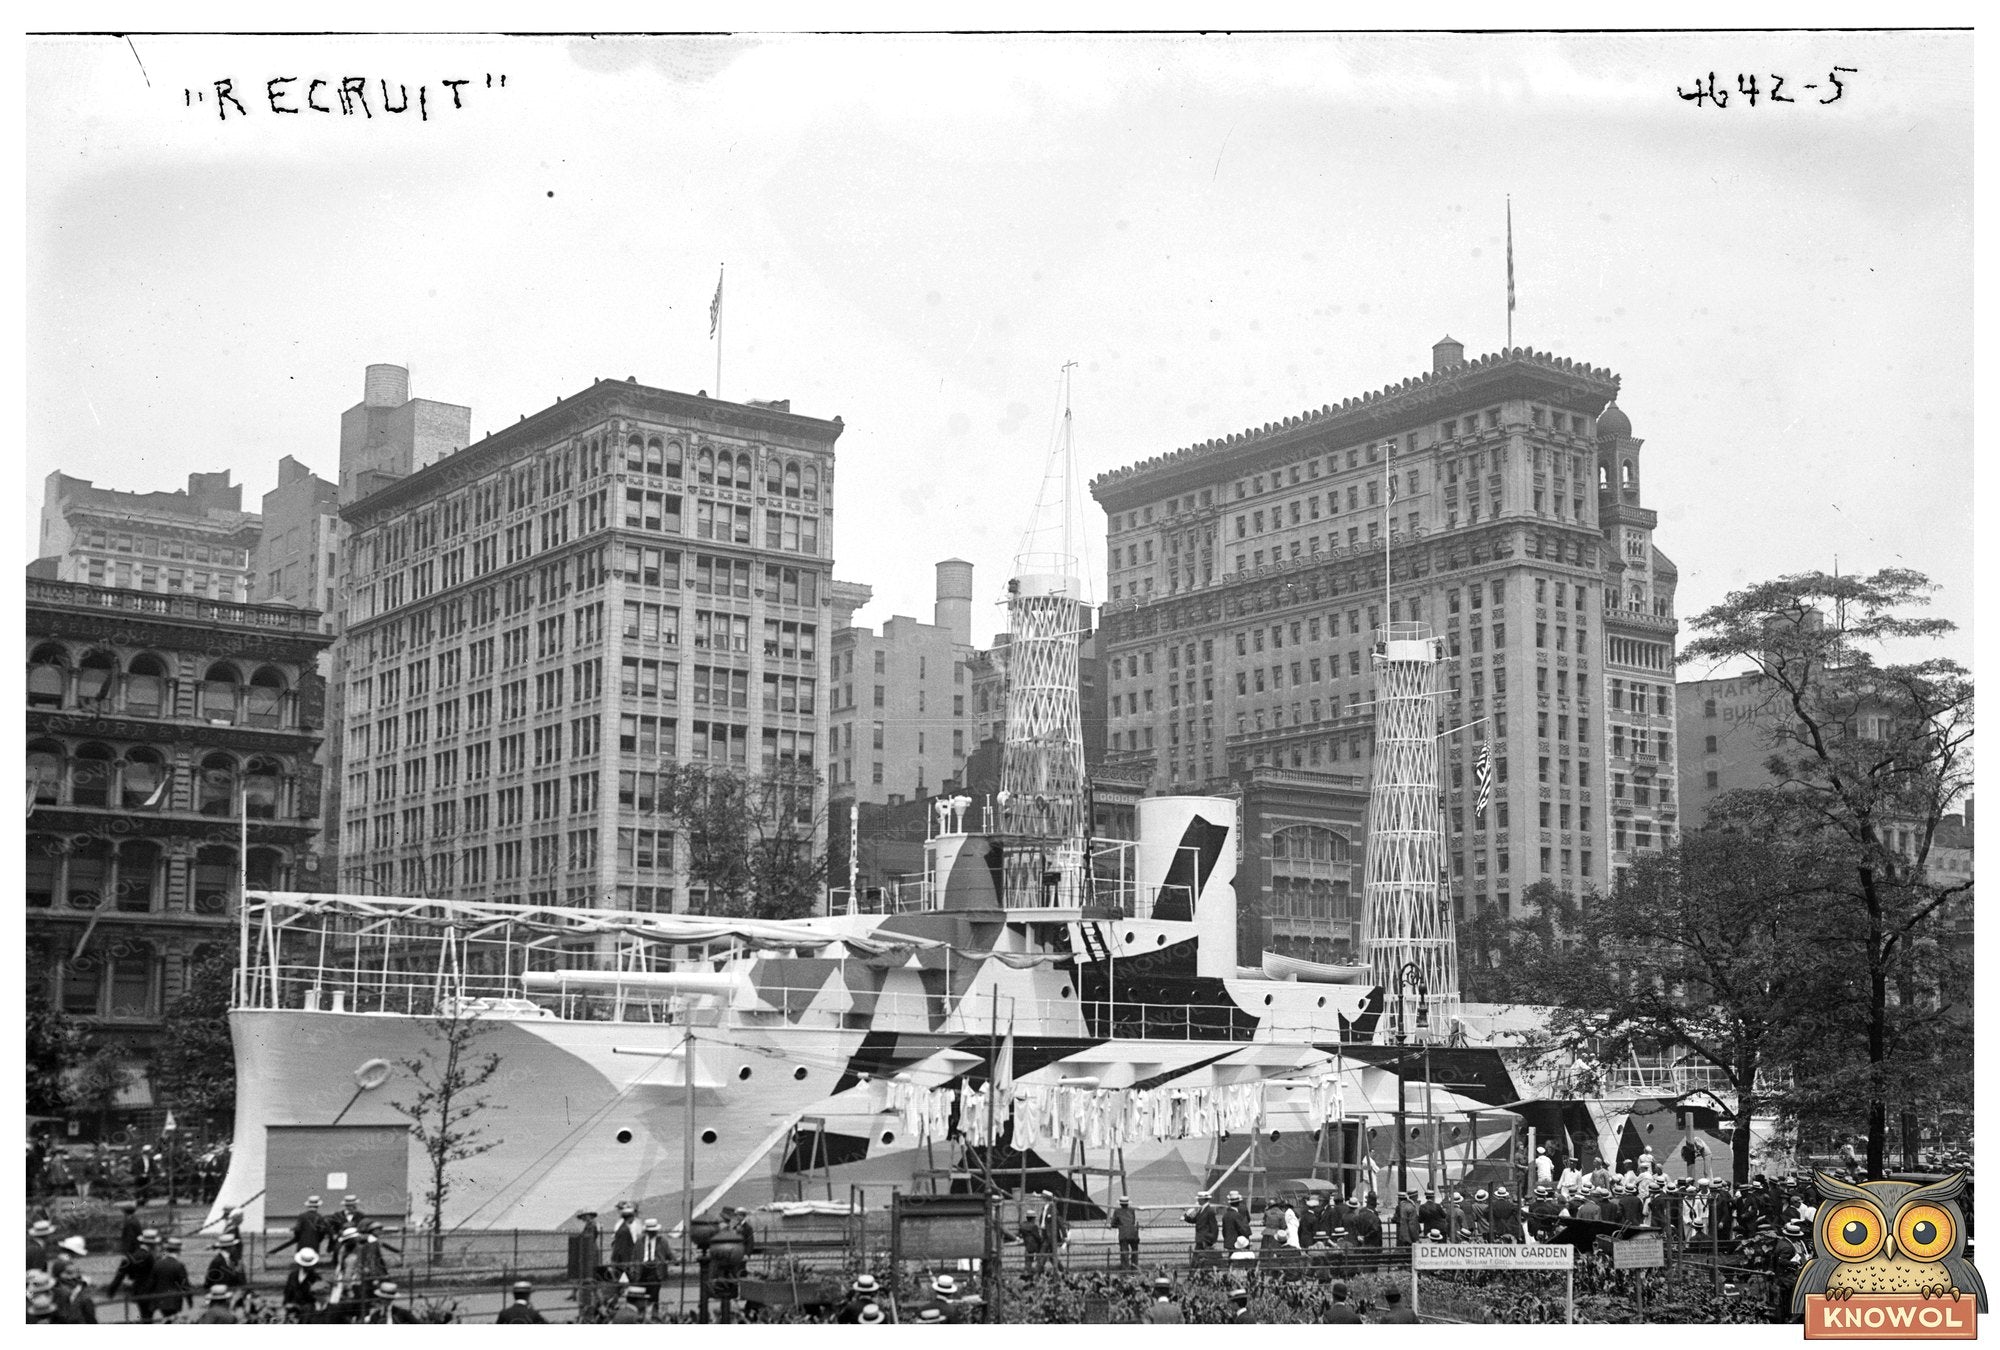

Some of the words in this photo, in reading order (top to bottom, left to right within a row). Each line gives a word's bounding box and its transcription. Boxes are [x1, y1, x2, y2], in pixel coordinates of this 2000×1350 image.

[1676, 66, 1858, 108] 4642-5
[1421, 1246, 1517, 1258] DEMONSTRATION
[1521, 1246, 1568, 1258] GARDEN
